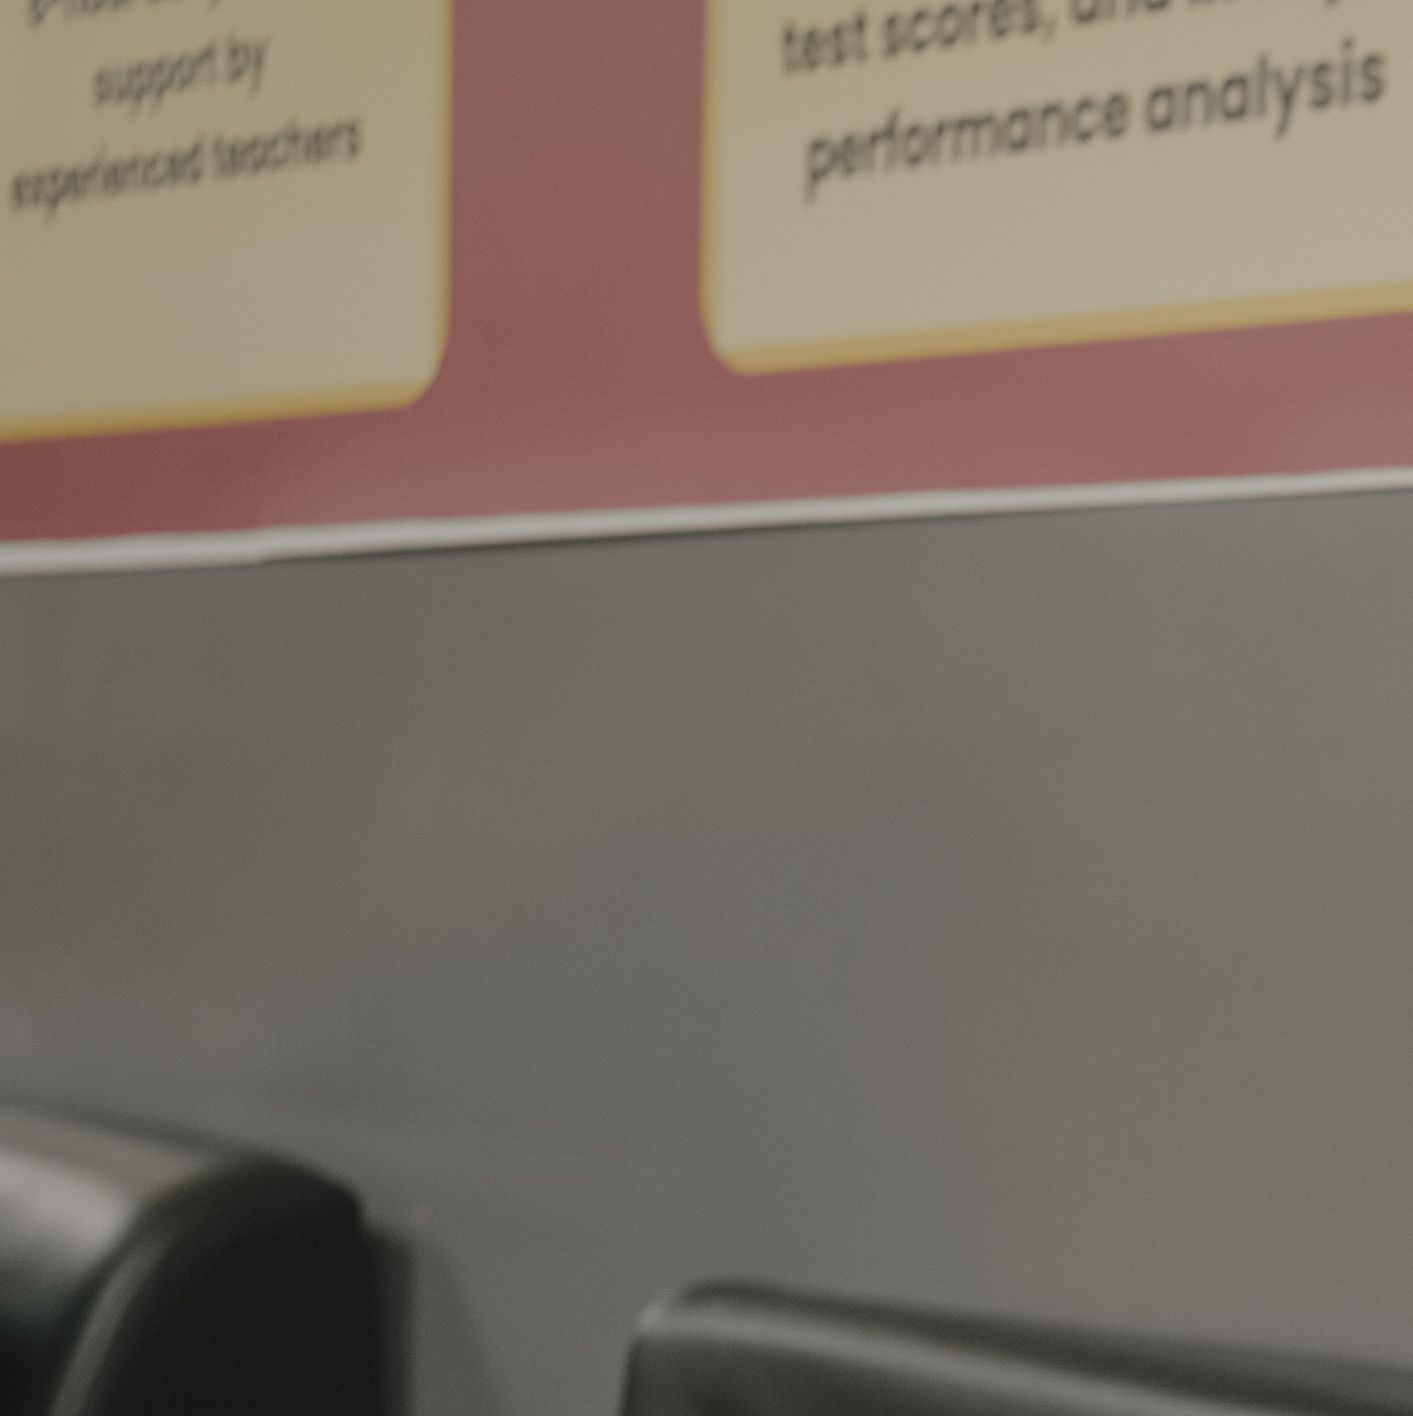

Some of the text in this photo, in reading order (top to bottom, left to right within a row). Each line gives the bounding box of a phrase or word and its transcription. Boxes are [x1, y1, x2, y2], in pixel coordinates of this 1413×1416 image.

[94, 32, 270, 118] support by
[783, 10, 868, 74] test
[882, 0, 1056, 52] scores,
[805, 38, 1386, 202] performance analysis
[12, 118, 362, 222] experienced teachers
